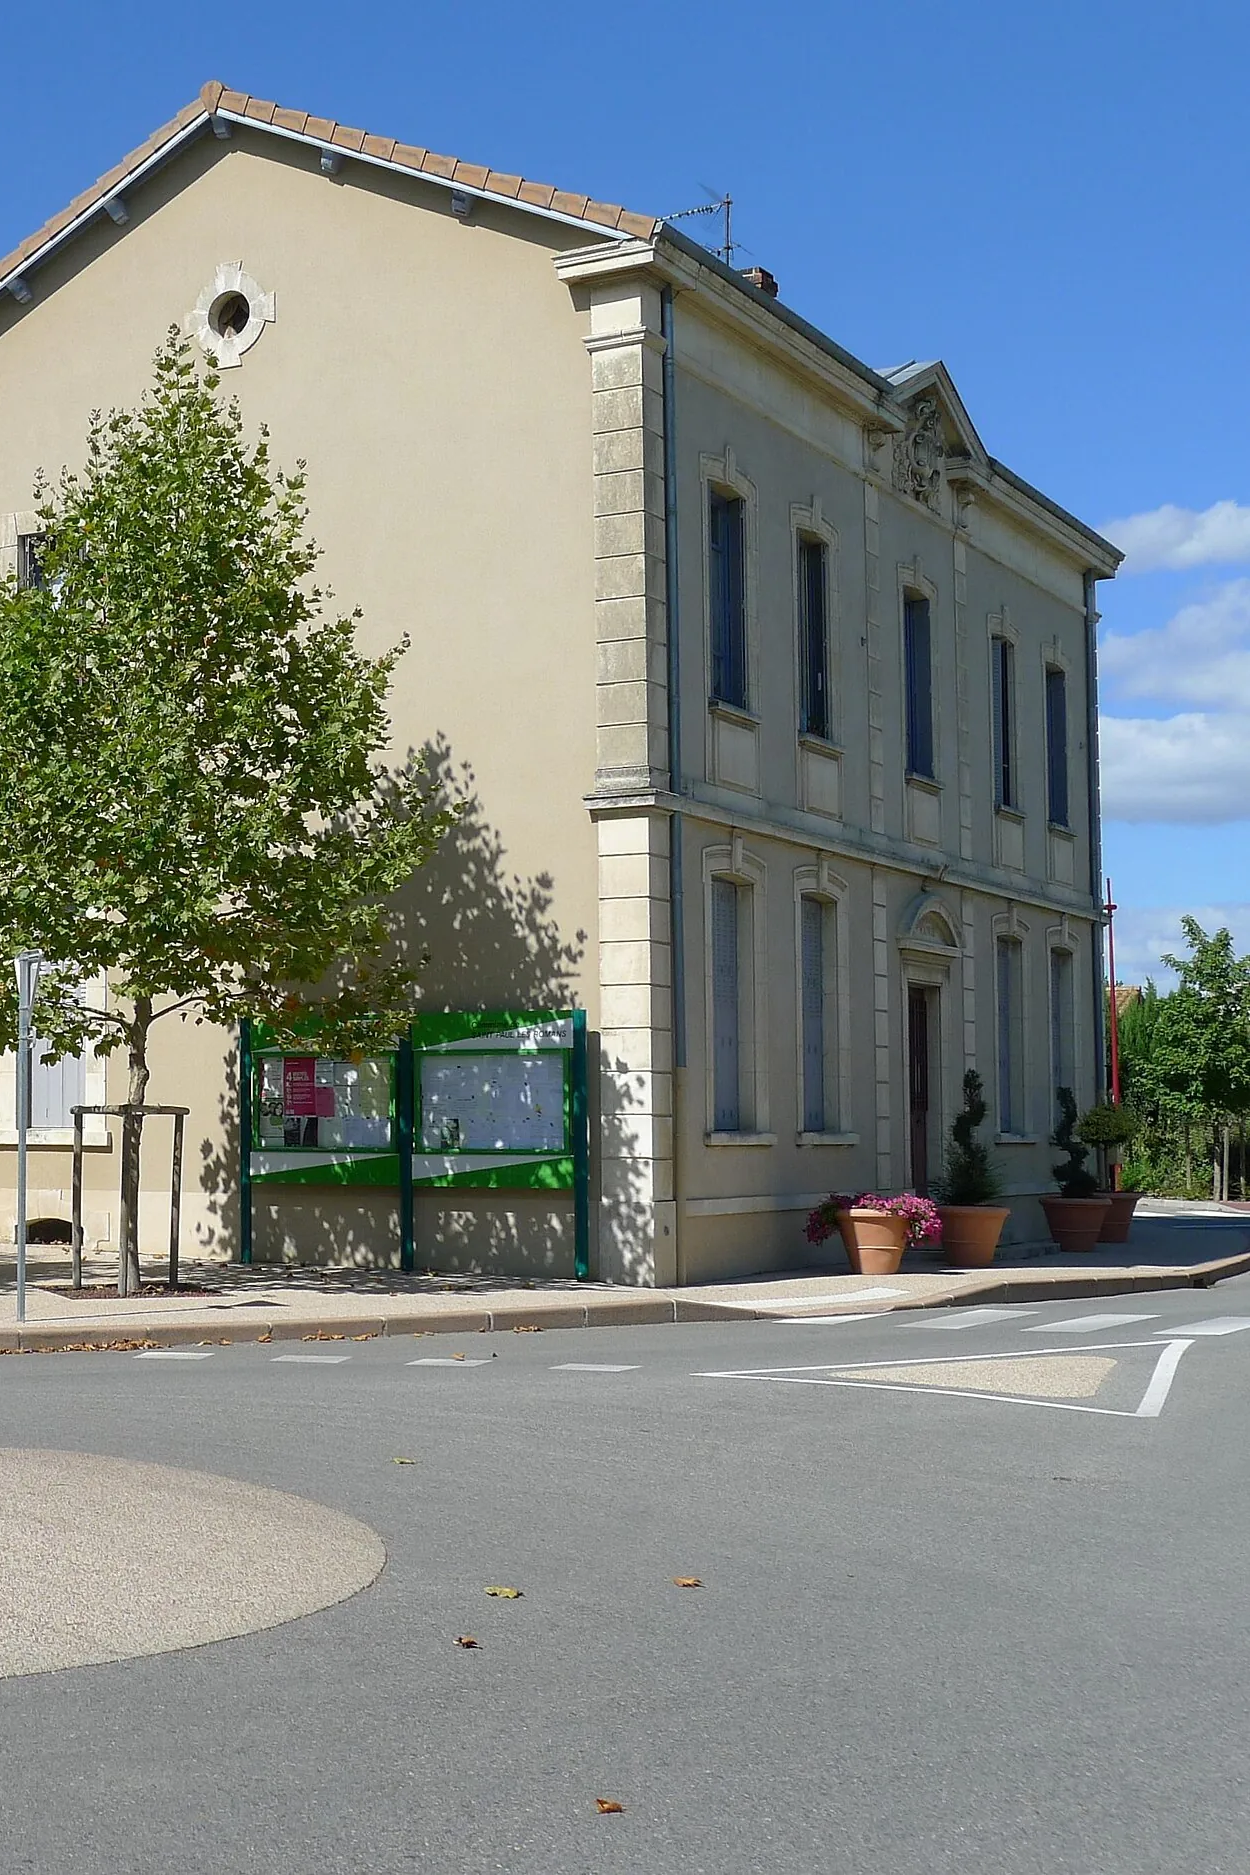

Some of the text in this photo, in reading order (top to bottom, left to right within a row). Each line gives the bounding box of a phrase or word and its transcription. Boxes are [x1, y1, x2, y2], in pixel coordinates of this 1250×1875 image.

[471, 1030, 567, 1039] SAINT PAUL LES ROMANS
